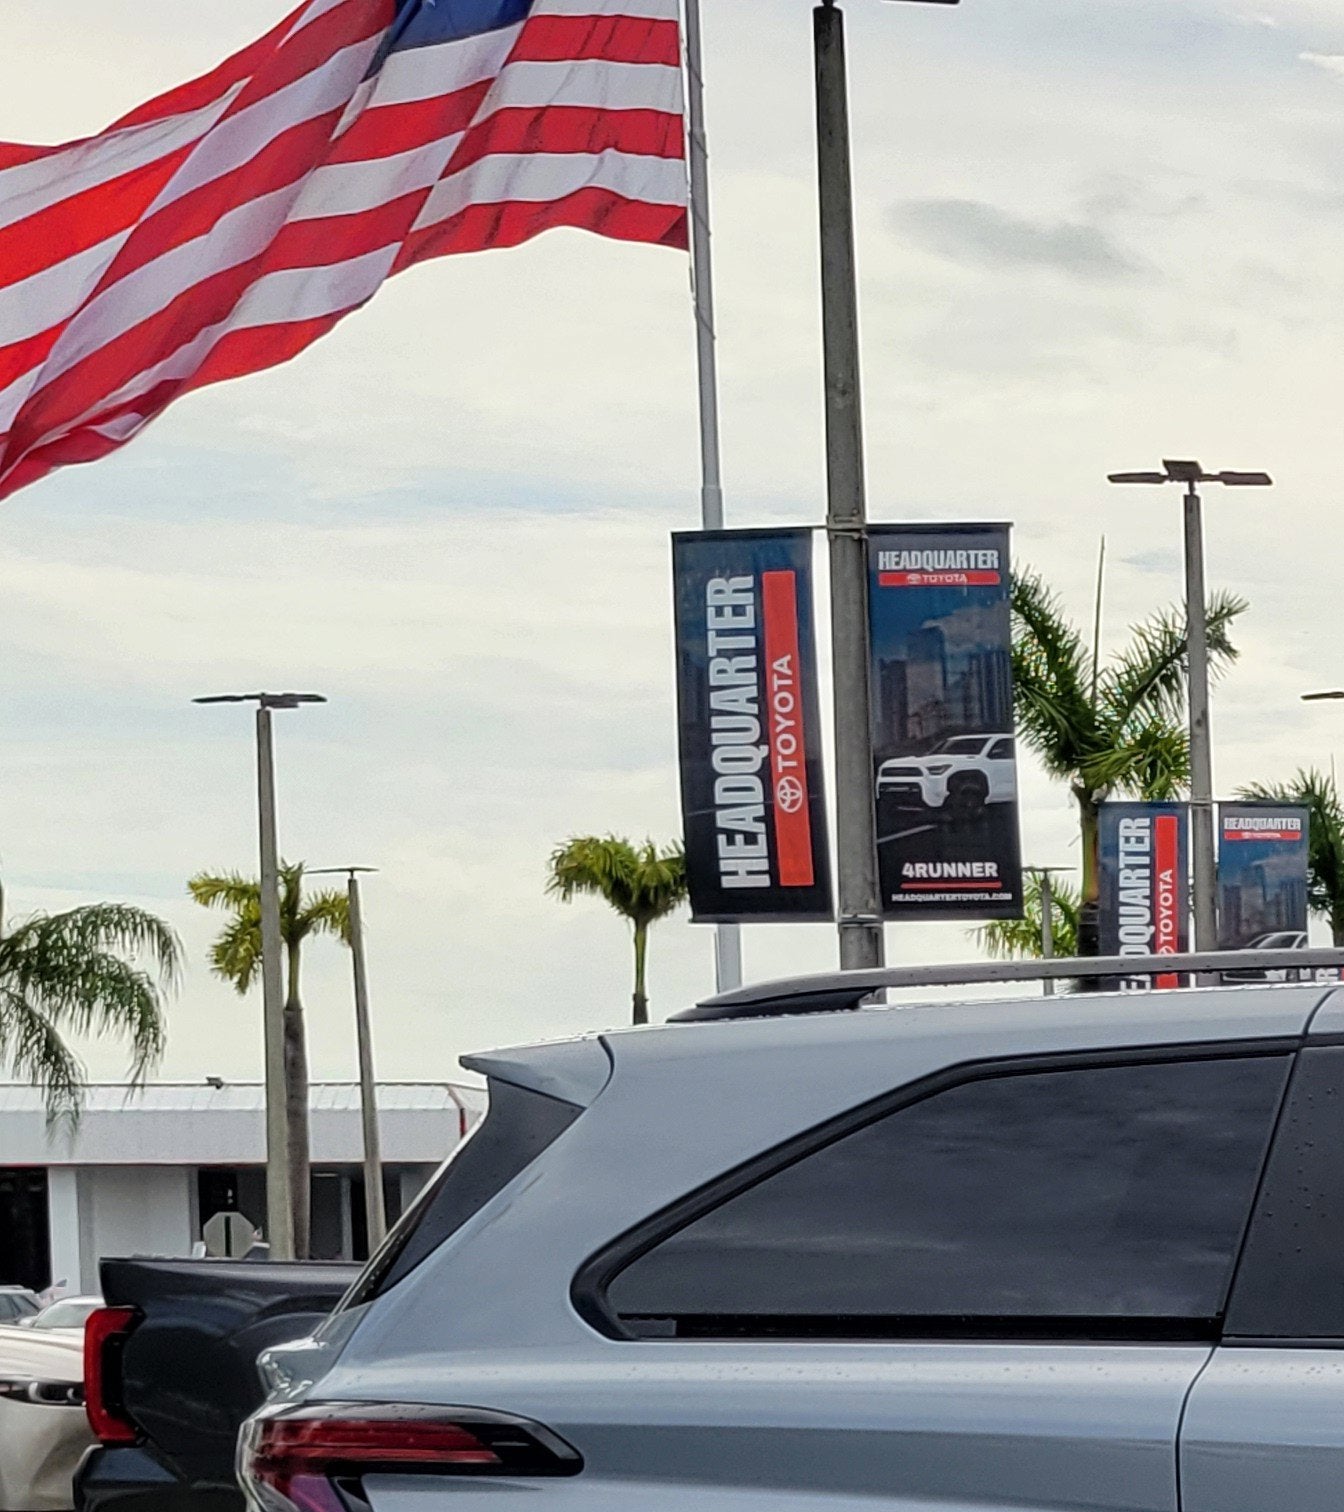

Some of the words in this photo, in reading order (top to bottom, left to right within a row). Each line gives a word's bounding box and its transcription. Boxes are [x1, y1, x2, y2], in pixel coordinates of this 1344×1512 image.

[878, 550, 999, 572] HEADQUARTER
[921, 573, 968, 584] TOYOTA
[706, 573, 771, 889] HEADQUARTER
[771, 654, 799, 773] TOYOTA
[902, 862, 999, 879] 4RUNNER
[1159, 868, 1173, 944] TOYOTA
